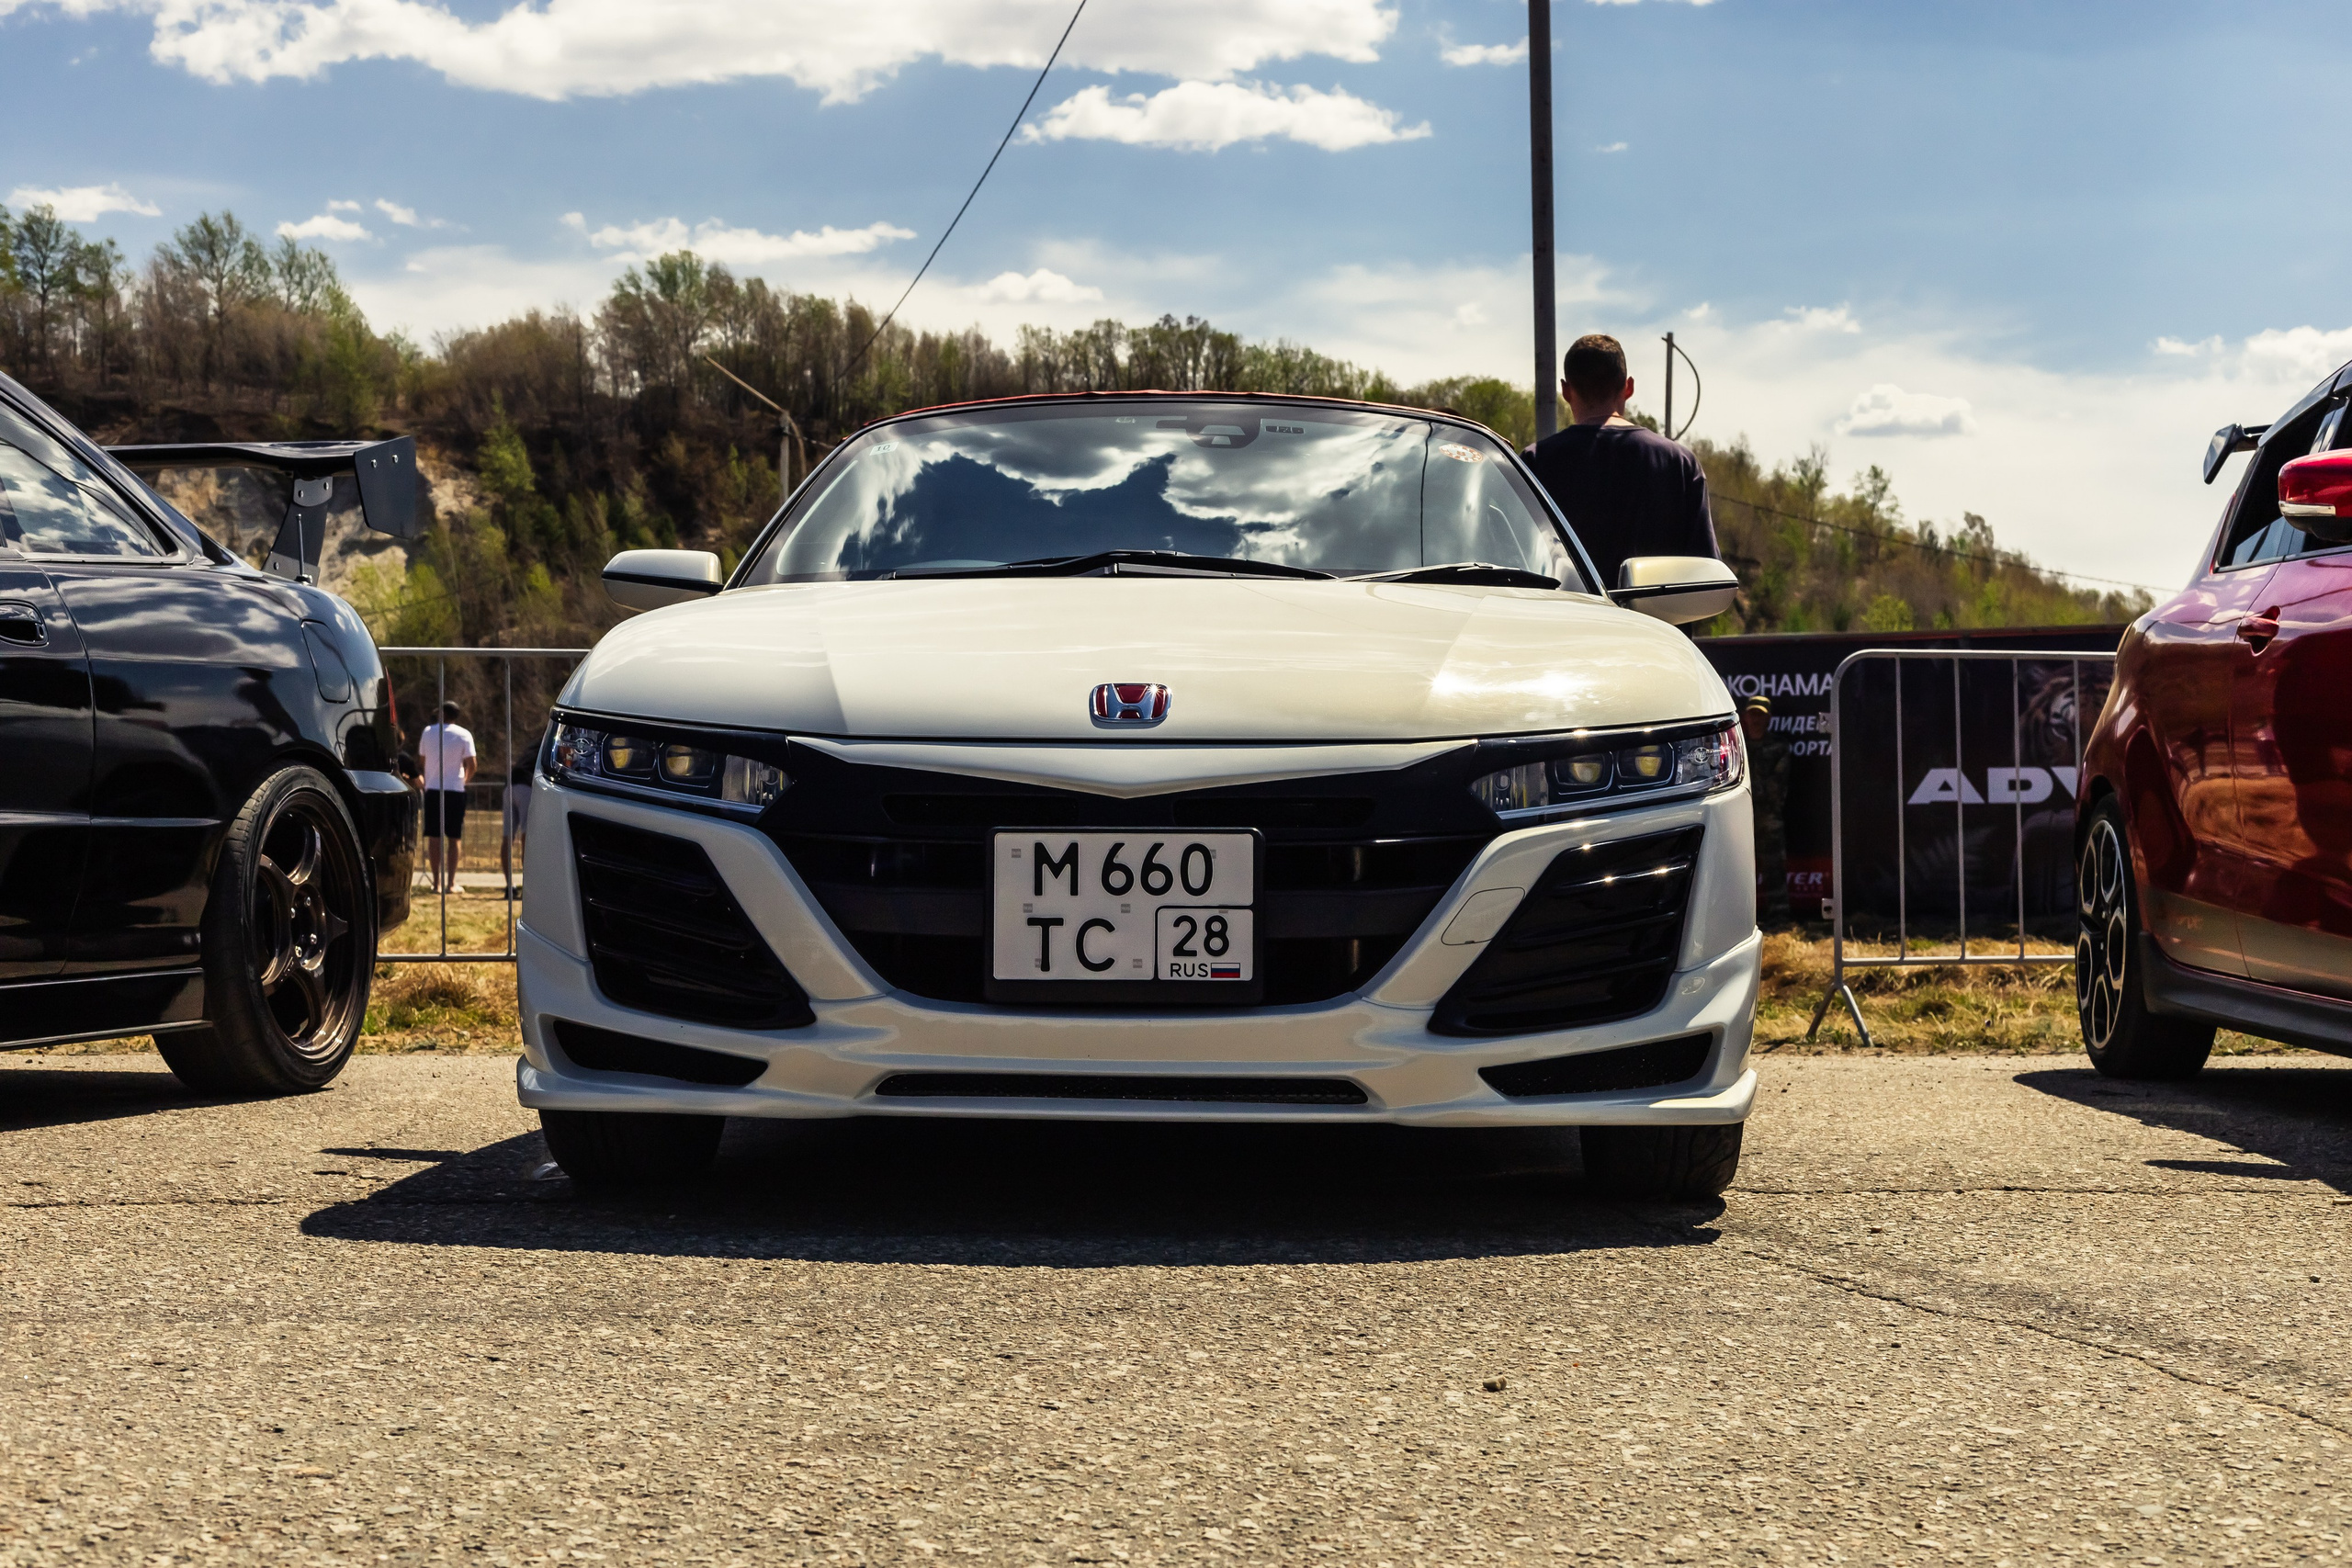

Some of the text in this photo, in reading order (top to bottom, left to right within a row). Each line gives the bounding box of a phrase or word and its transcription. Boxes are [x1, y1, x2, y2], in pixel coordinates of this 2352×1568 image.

[1724, 673, 1832, 697] KOHAMA
[1768, 716, 1820, 734] ЛИДЕ
[1789, 740, 1832, 756] ОРТ
[1101, 842, 1214, 897] 660
[1172, 915, 1230, 957] 28
[1170, 963, 1209, 978] RUS
